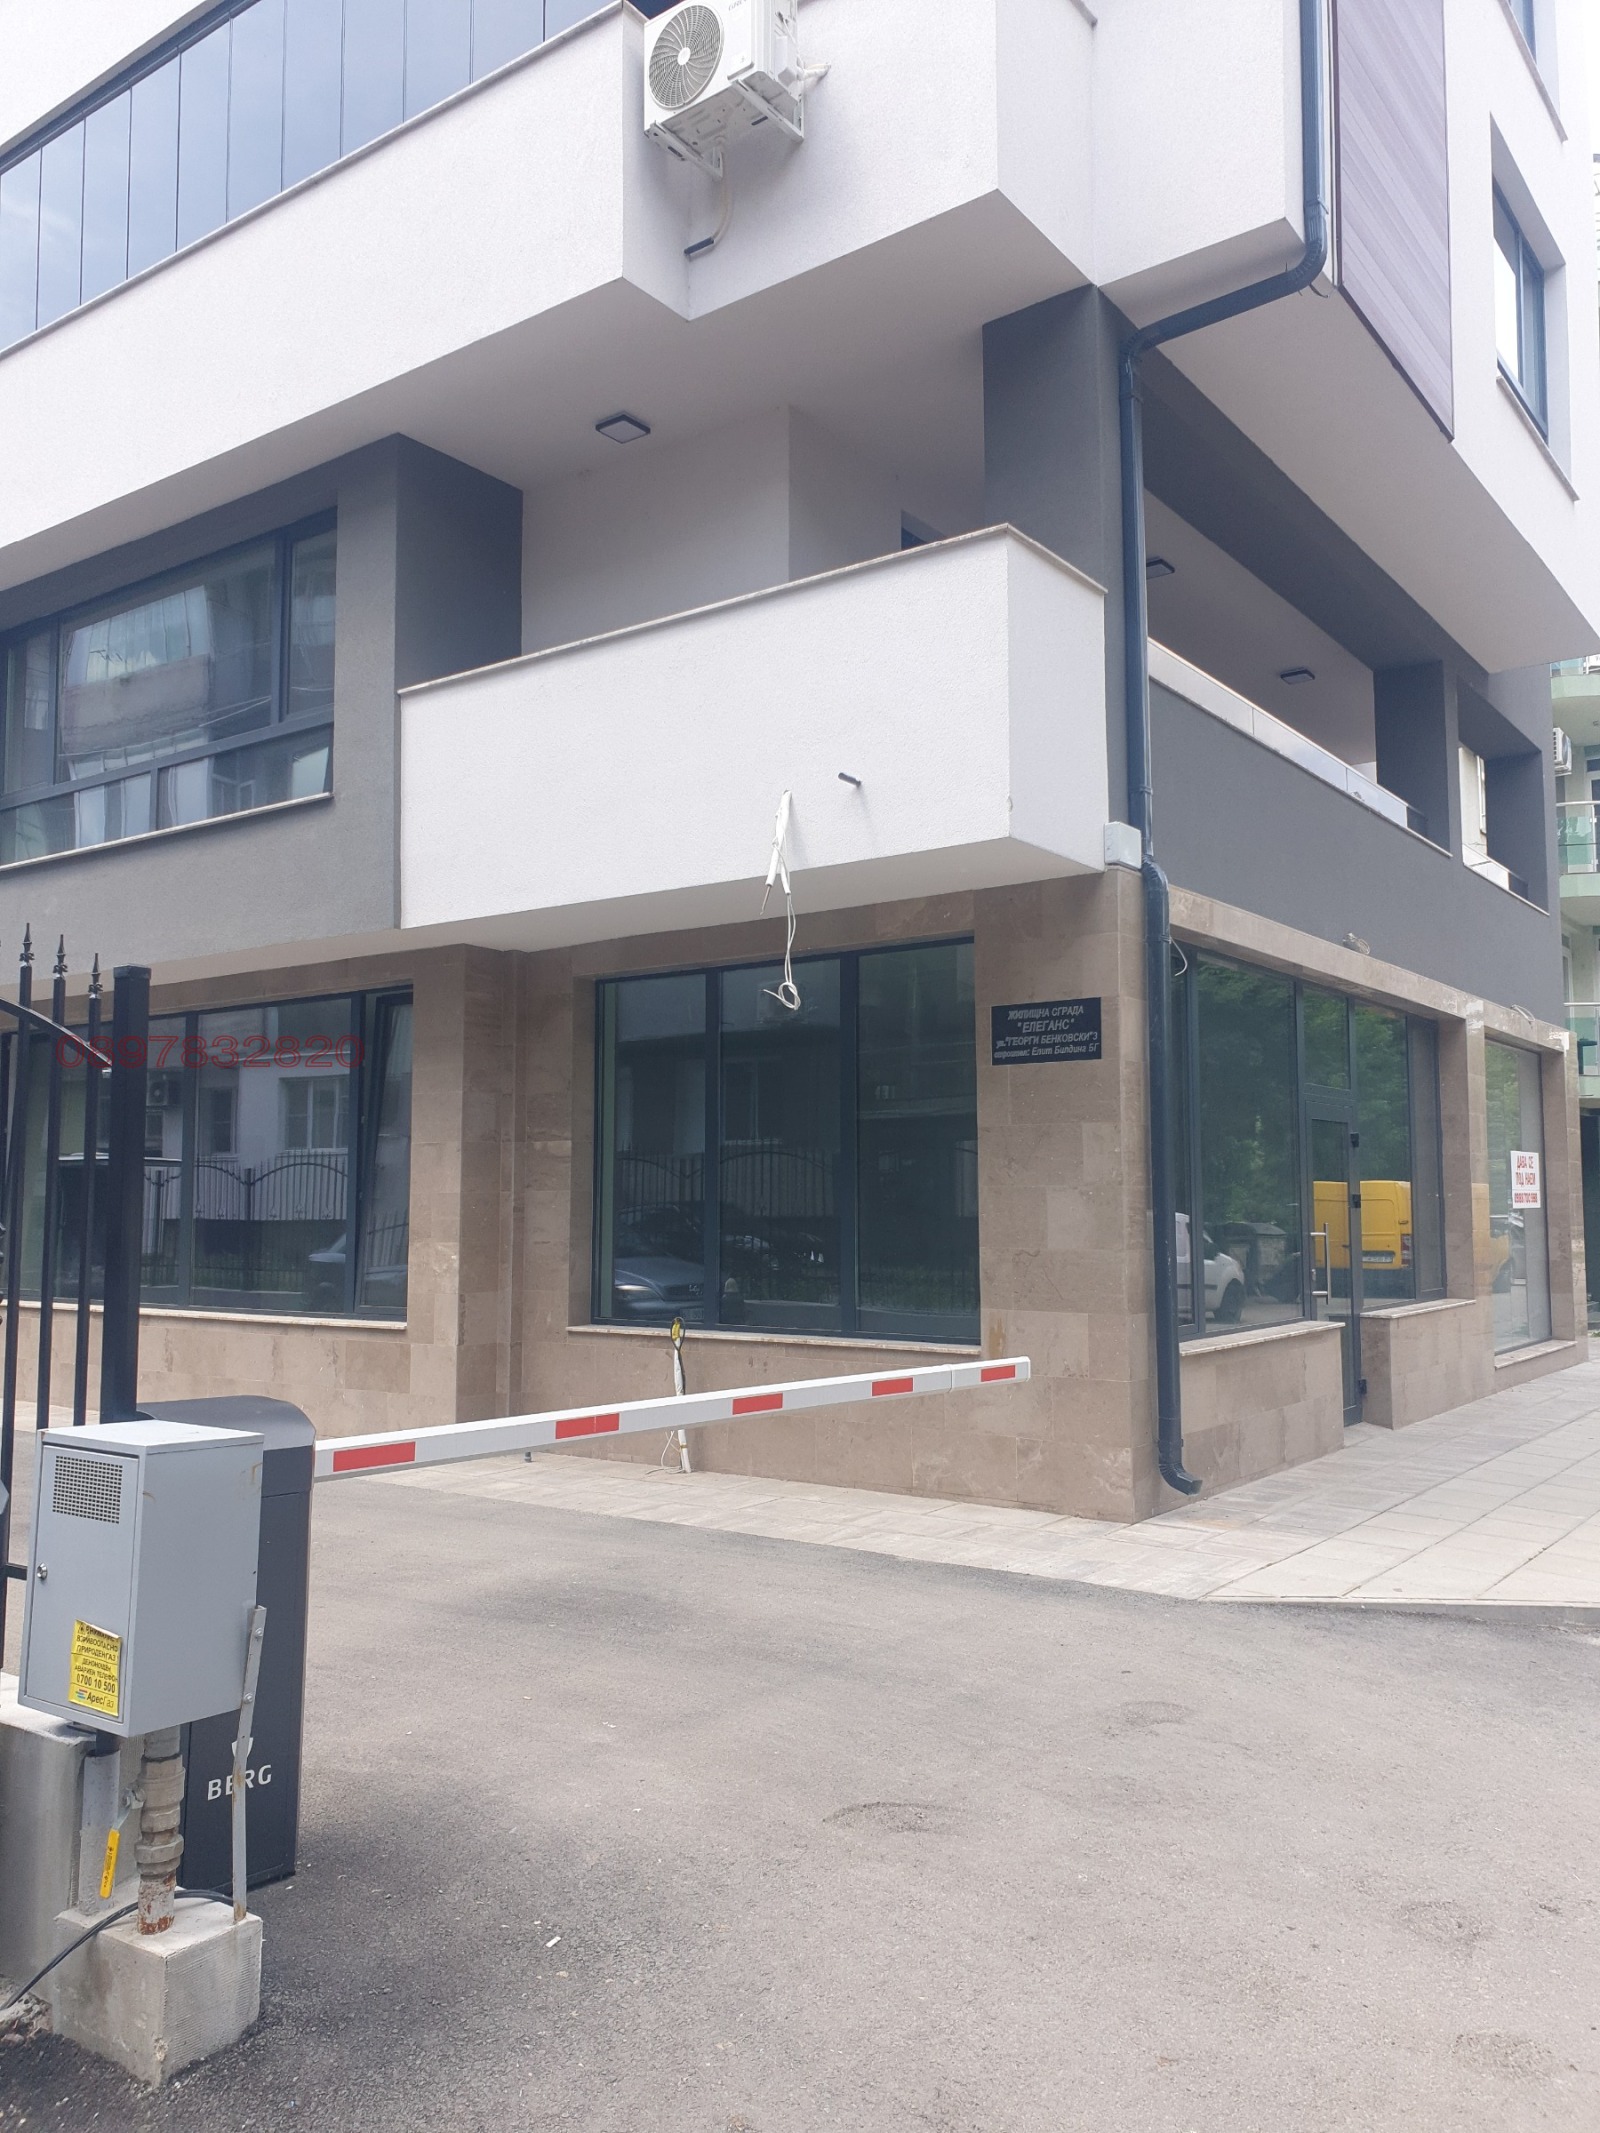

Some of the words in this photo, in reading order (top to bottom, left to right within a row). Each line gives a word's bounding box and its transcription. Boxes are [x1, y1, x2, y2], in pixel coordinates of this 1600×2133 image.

[1008, 1008, 1049, 1020] ЖИЛИЩНА
[1051, 1005, 1084, 1017] СГРАДА
[1031, 1046, 1053, 1056] Елит
[1054, 1044, 1087, 1055] Билдинг
[76, 1673, 92, 1687] 0700
[94, 1678, 102, 1689] 10
[103, 1681, 116, 1694] 500
